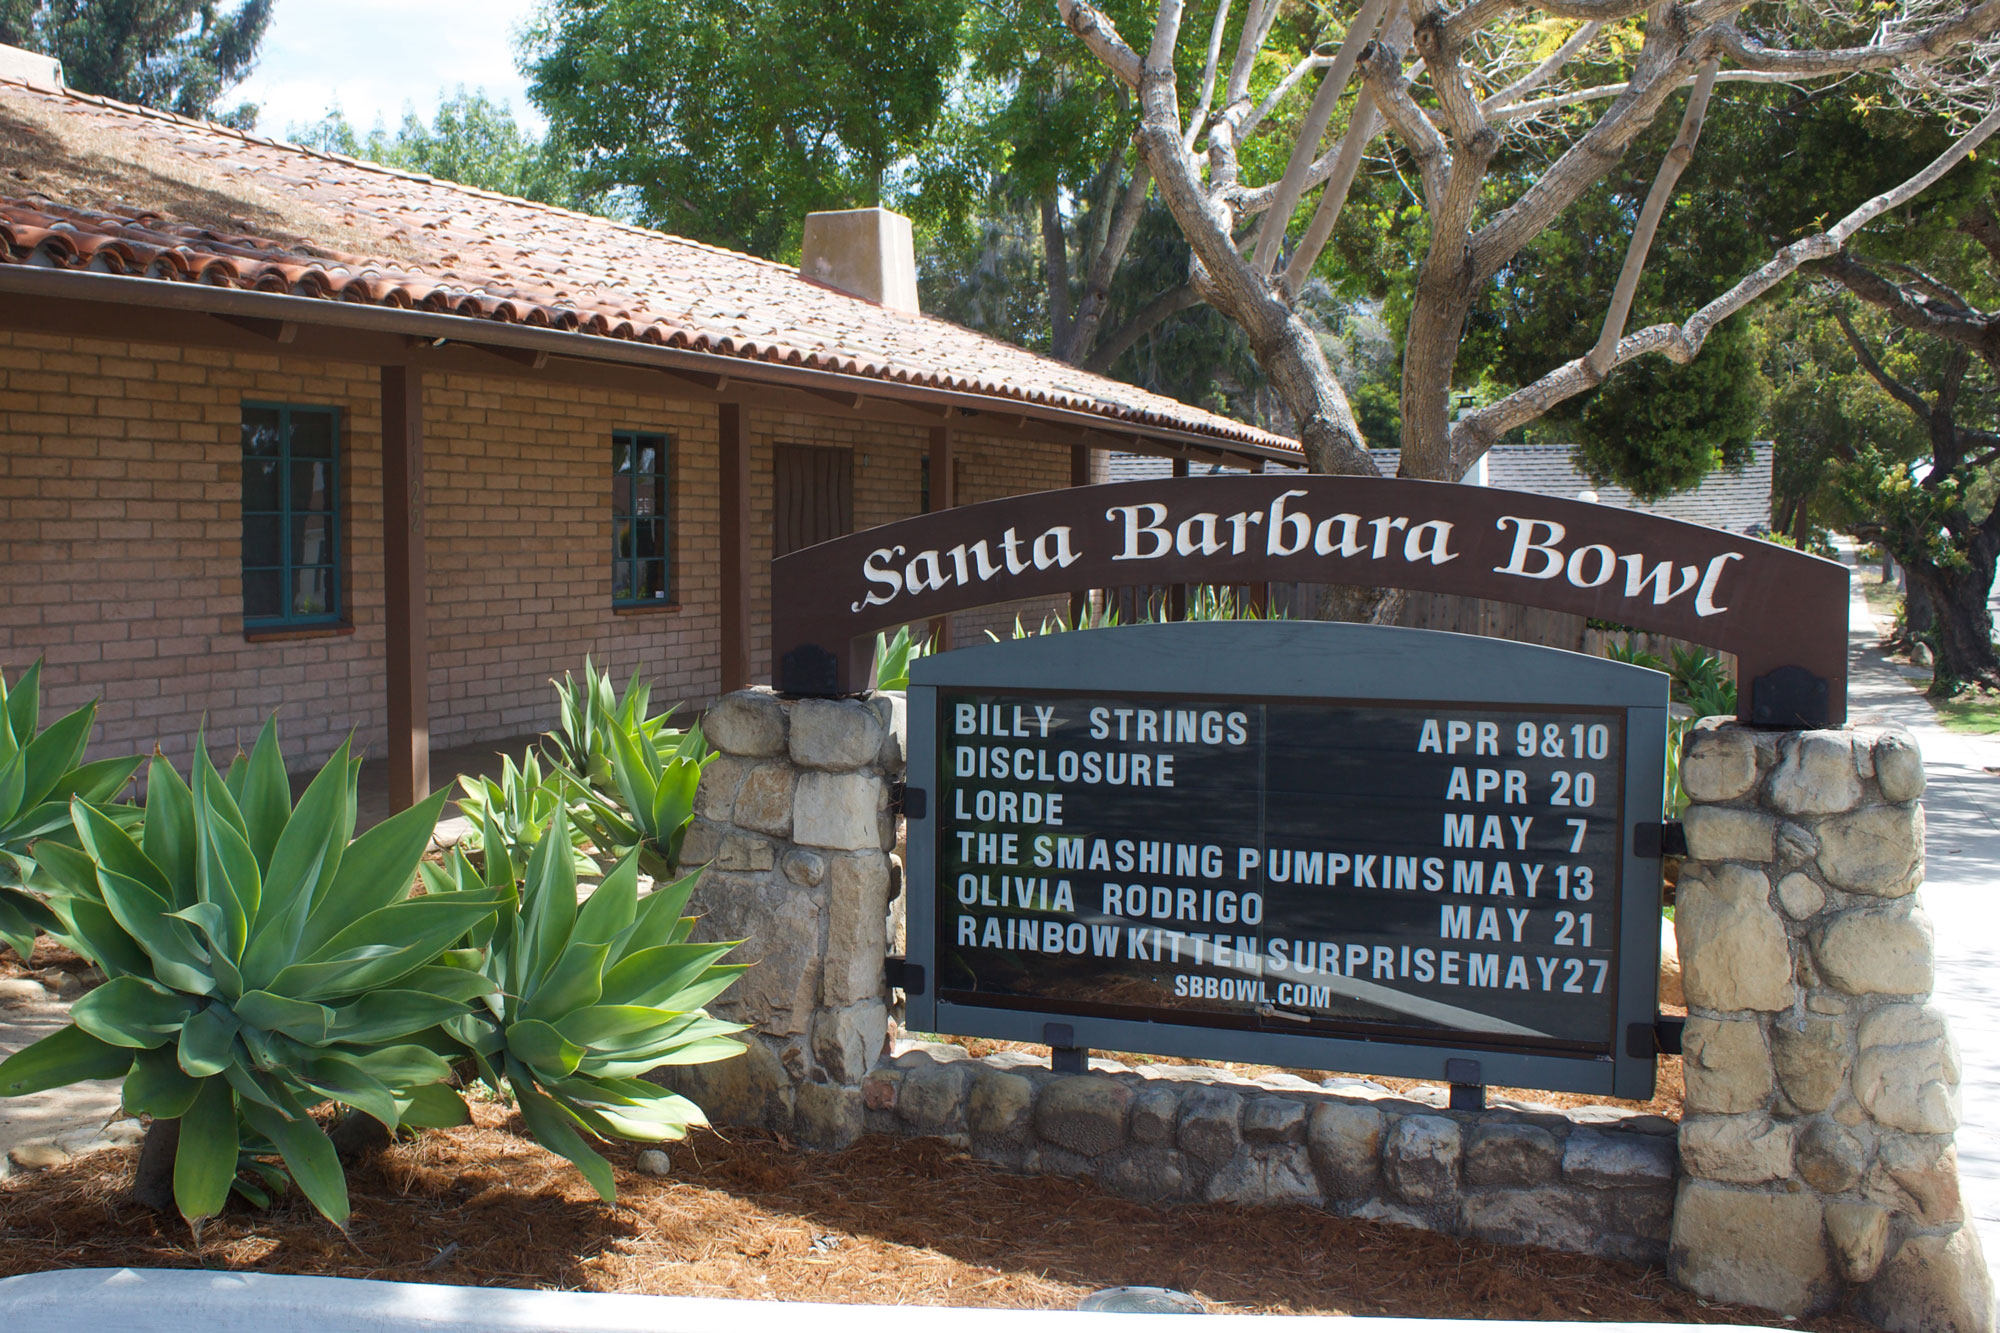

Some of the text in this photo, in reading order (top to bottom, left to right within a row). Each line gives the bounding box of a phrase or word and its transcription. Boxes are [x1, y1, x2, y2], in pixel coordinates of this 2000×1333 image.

[851, 489, 1744, 617] Santa Barbara Bowl
[955, 703, 1609, 760] BILLY STRINGS APR 9&10
[955, 746, 1596, 808] DISCLOSURE APR 20
[955, 788, 1587, 853] LORDE MAY 7
[956, 831, 1594, 901] THE SMASHING PUMPKINS MAY 13
[958, 873, 1593, 948] OLIVIA RODRIGO MAY 21
[957, 915, 1121, 958] RAINBOW
[1266, 937, 1460, 985] SURPRISE
[1468, 952, 1560, 992] MAY
[1563, 958, 1609, 994] 27
[1174, 974, 1331, 1009] SBBOWL.COM
